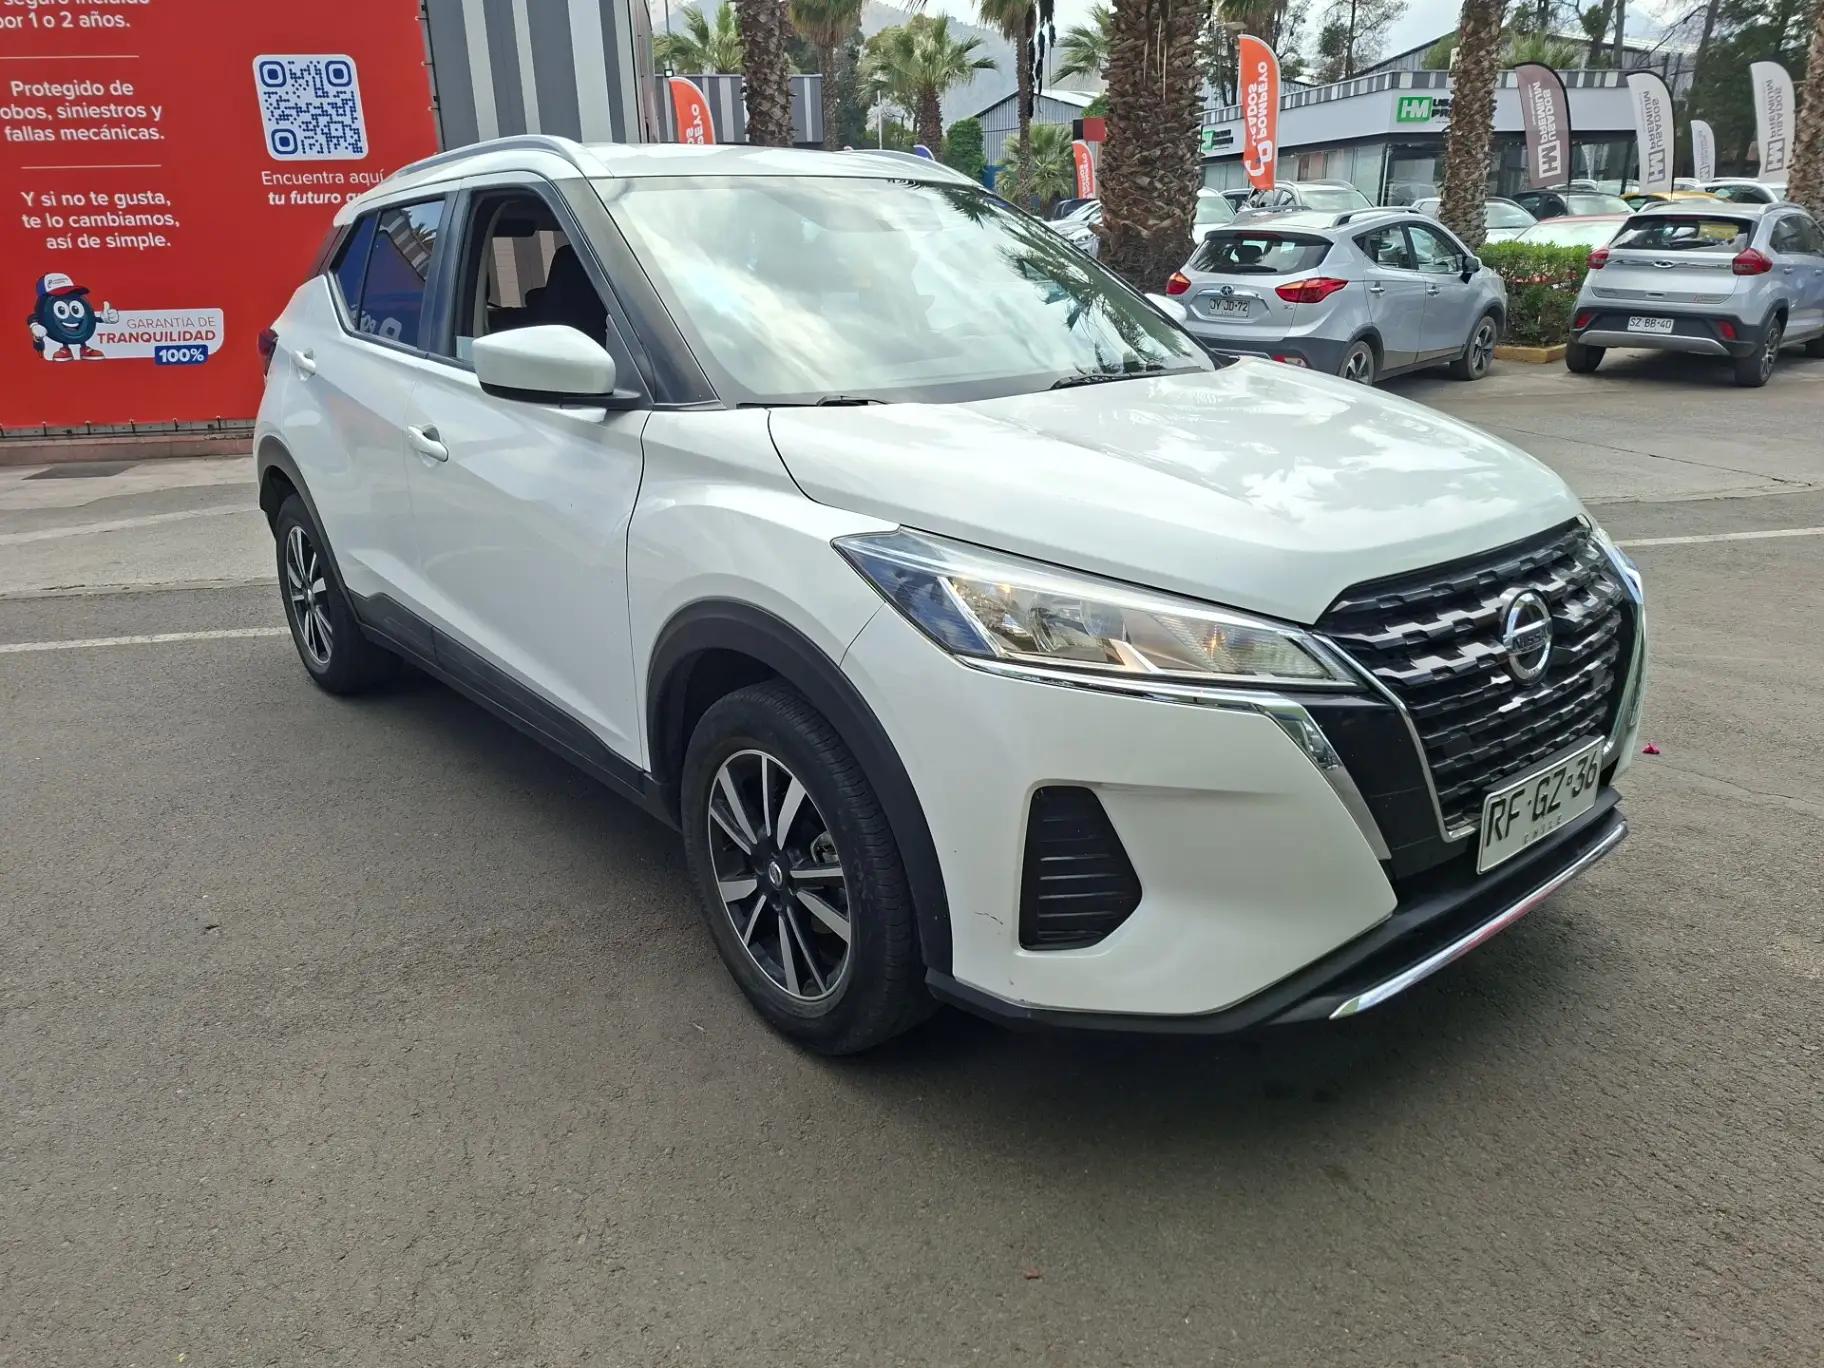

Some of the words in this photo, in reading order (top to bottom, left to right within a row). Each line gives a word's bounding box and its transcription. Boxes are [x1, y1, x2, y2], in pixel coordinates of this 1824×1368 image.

[28, 11, 38, 28] 1
[43, 15, 55, 28] o
[59, 10, 74, 28] 2
[79, 11, 131, 28] años.
[10, 79, 105, 101] Protegido
[109, 79, 134, 96] de
[0, 103, 53, 121] obos,
[56, 102, 147, 119] siniestros
[150, 105, 162, 122] y
[1400, 99, 1430, 118] HM
[4, 125, 56, 142] fallas
[60, 124, 165, 141] mecánicas.
[261, 170, 345, 186] Encuentra
[349, 168, 385, 186] aquí
[20, 191, 35, 207] Y
[40, 191, 57, 207] si
[61, 193, 86, 206] no
[89, 191, 109, 206] te
[114, 190, 171, 209] gusta,
[267, 191, 285, 206] tu
[289, 190, 342, 205] futuro
[21, 213, 42, 229] te
[46, 212, 64, 228] lo
[68, 211, 180, 228] cambiamos,
[46, 232, 73, 250] así
[77, 233, 101, 249] de
[105, 232, 171, 251] simple.
[197, 316, 216, 328] DE
[97, 329, 216, 344] TRANQUILIDAD
[158, 347, 205, 362] 100%
